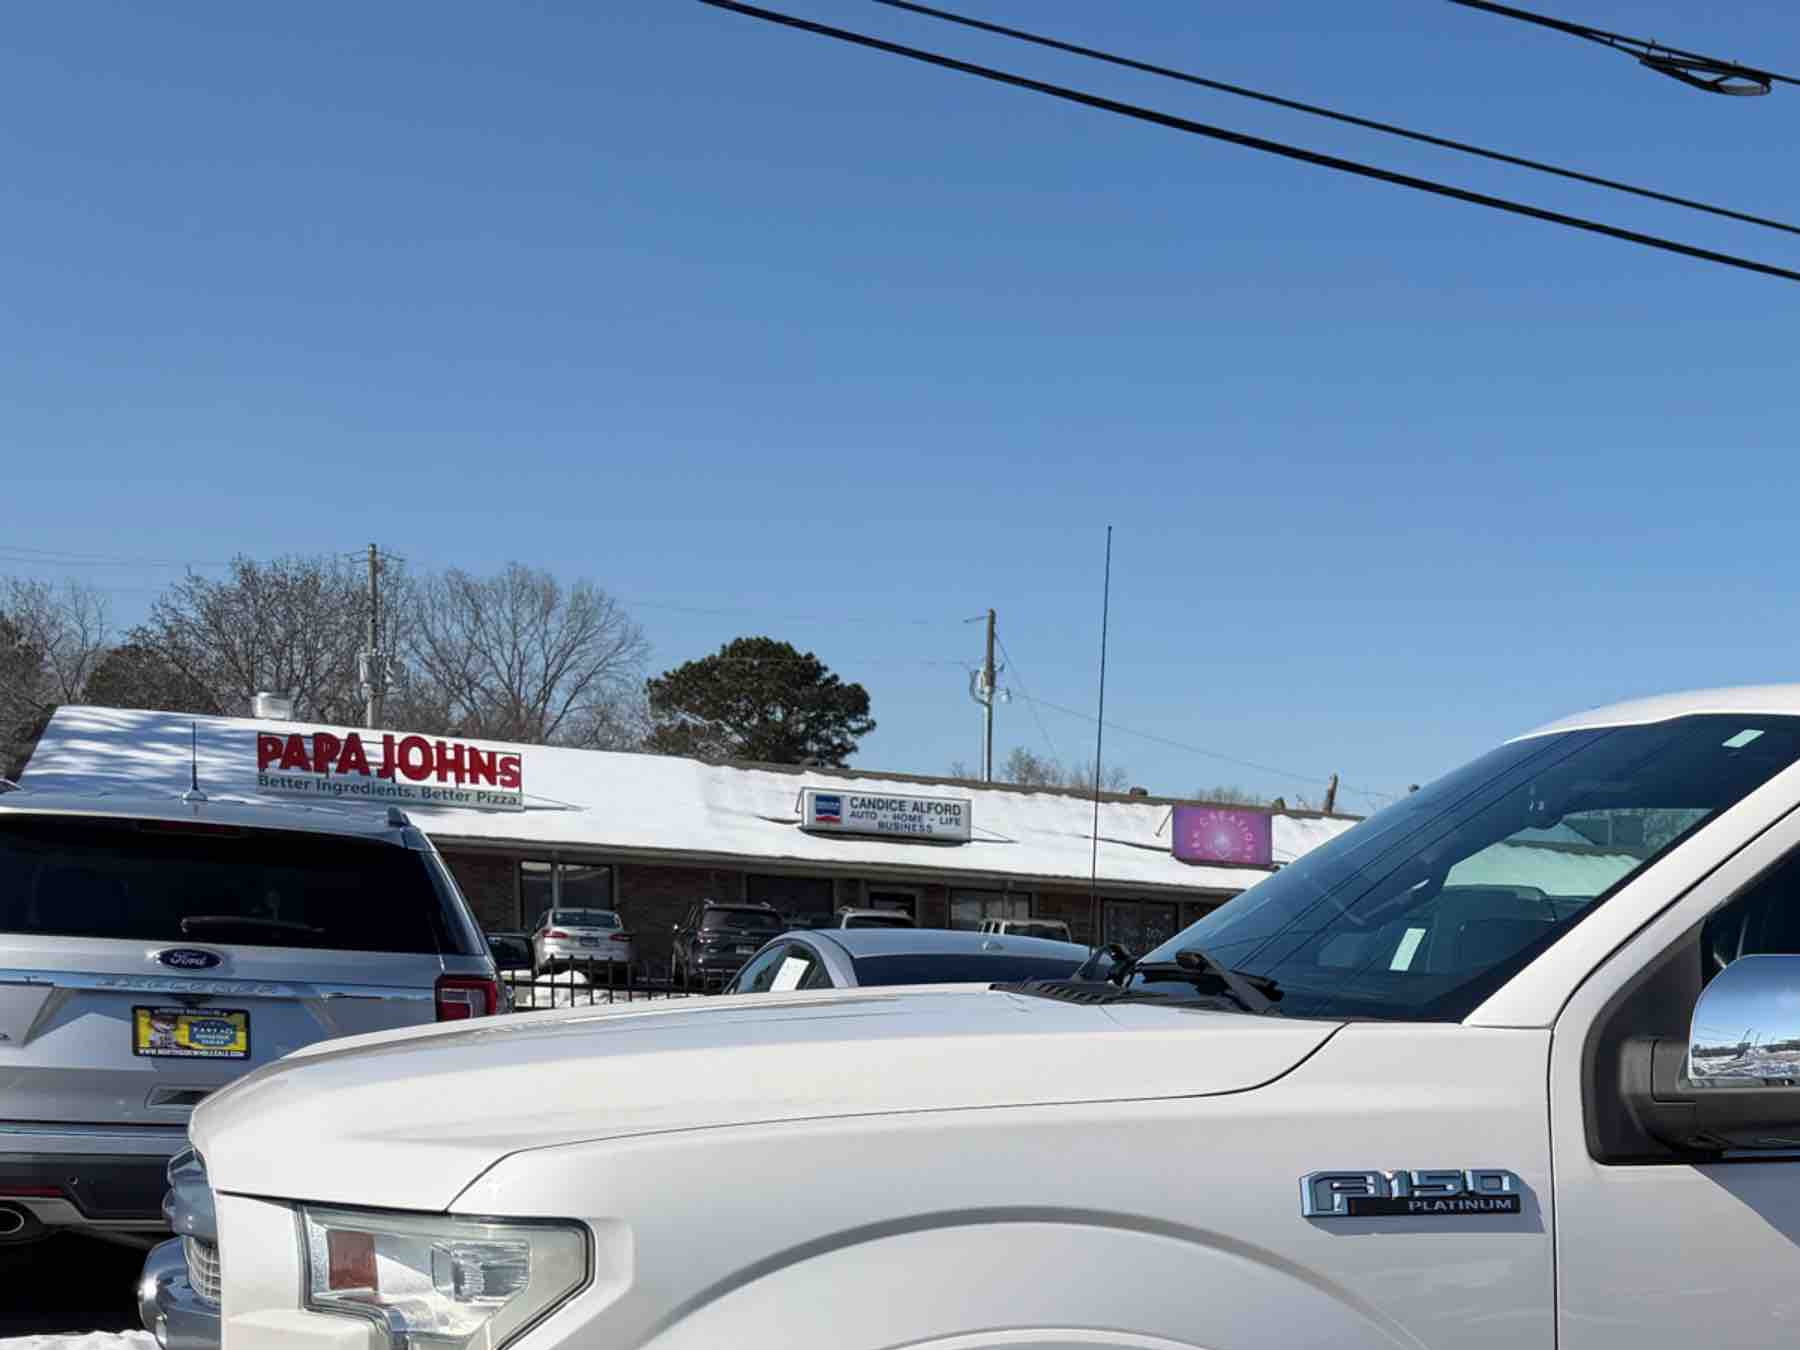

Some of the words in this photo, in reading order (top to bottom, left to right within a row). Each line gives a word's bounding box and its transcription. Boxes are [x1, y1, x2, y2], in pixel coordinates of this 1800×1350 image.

[257, 732, 370, 776] PAPA
[377, 734, 522, 788] JOHNS
[257, 773, 311, 792] Better
[317, 778, 416, 799] Ingredients.
[421, 784, 472, 802] Better
[850, 796, 906, 811] CANDICE
[911, 800, 961, 816] ALFORD
[850, 810, 877, 820] AUTO
[892, 813, 923, 823] HOME
[939, 817, 961, 827] LIFE
[878, 821, 933, 834] BUSINESS
[1408, 1200, 1512, 1212] PLATINUM
